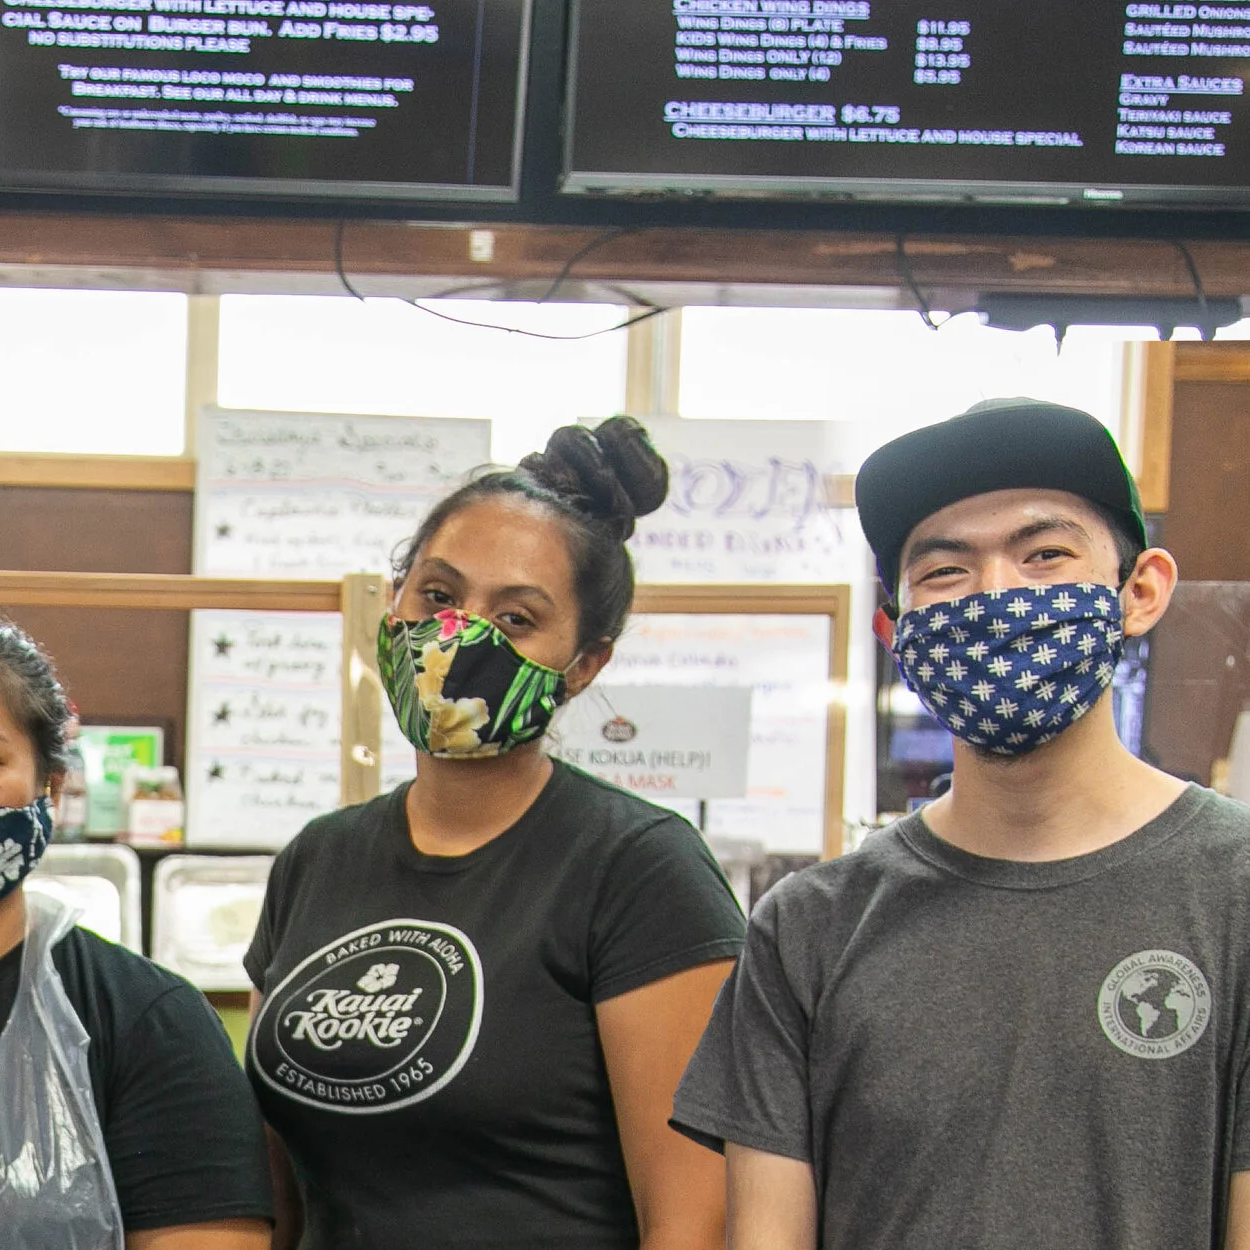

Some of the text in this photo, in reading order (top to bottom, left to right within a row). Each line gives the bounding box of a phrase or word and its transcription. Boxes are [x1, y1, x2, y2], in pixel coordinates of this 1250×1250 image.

[203, 0, 285, 16] LETTUCE
[286, 1, 327, 17] AND
[327, 3, 391, 20] HOUSE
[1125, 3, 1197, 19] GRILLED
[1, 11, 47, 28] CIAL
[47, 11, 112, 31] SAUCE
[112, 16, 143, 32] ON
[147, 15, 226, 34] BURGER
[277, 20, 321, 38] ADD
[322, 22, 379, 41] FRIES
[676, 16, 719, 30] WING
[719, 16, 767, 31] DINGS
[790, 19, 845, 33] PLATE
[28, 30, 56, 46] NO
[184, 36, 250, 53] PLEASE
[676, 31, 717, 46] KIDS
[717, 32, 759, 47] WING
[759, 33, 807, 49] DINGS
[844, 34, 889, 50] FRIES
[675, 47, 718, 62] WING
[718, 49, 766, 64] DINGS
[766, 50, 811, 65] ONLY
[181, 70, 221, 85] LOCO
[221, 71, 266, 86] MOCO
[268, 73, 300, 87] AND
[382, 77, 415, 92] FOR
[675, 63, 718, 79] WING
[718, 65, 767, 80] DINGS
[769, 67, 808, 80] ONLY
[1120, 73, 1244, 92] EXTRA SAUCES
[161, 84, 192, 100] SEE
[225, 89, 251, 102] ALL
[664, 101, 837, 119] CHEESEBURGER
[1182, 110, 1232, 124] SAUCE
[671, 122, 1084, 147] CHEESEBURGER WITH LETTUCE AND HOUSE SPECIAL
[1116, 123, 1216, 140] KATSU SAUCE
[1115, 139, 1226, 156] KOREAN SAUCE
[590, 750, 647, 766] KOKUA
[629, 774, 677, 790] MASK
[325, 929, 465, 976] BAKED WITH ALOHA
[1107, 954, 1207, 998] GLOBAL AWARENESS
[306, 987, 423, 1020] Kauai
[284, 1009, 413, 1051] Kookie
[1103, 1002, 1170, 1054] INTERNATIONAL
[275, 1056, 435, 1101] ESTABLISHED 1965
